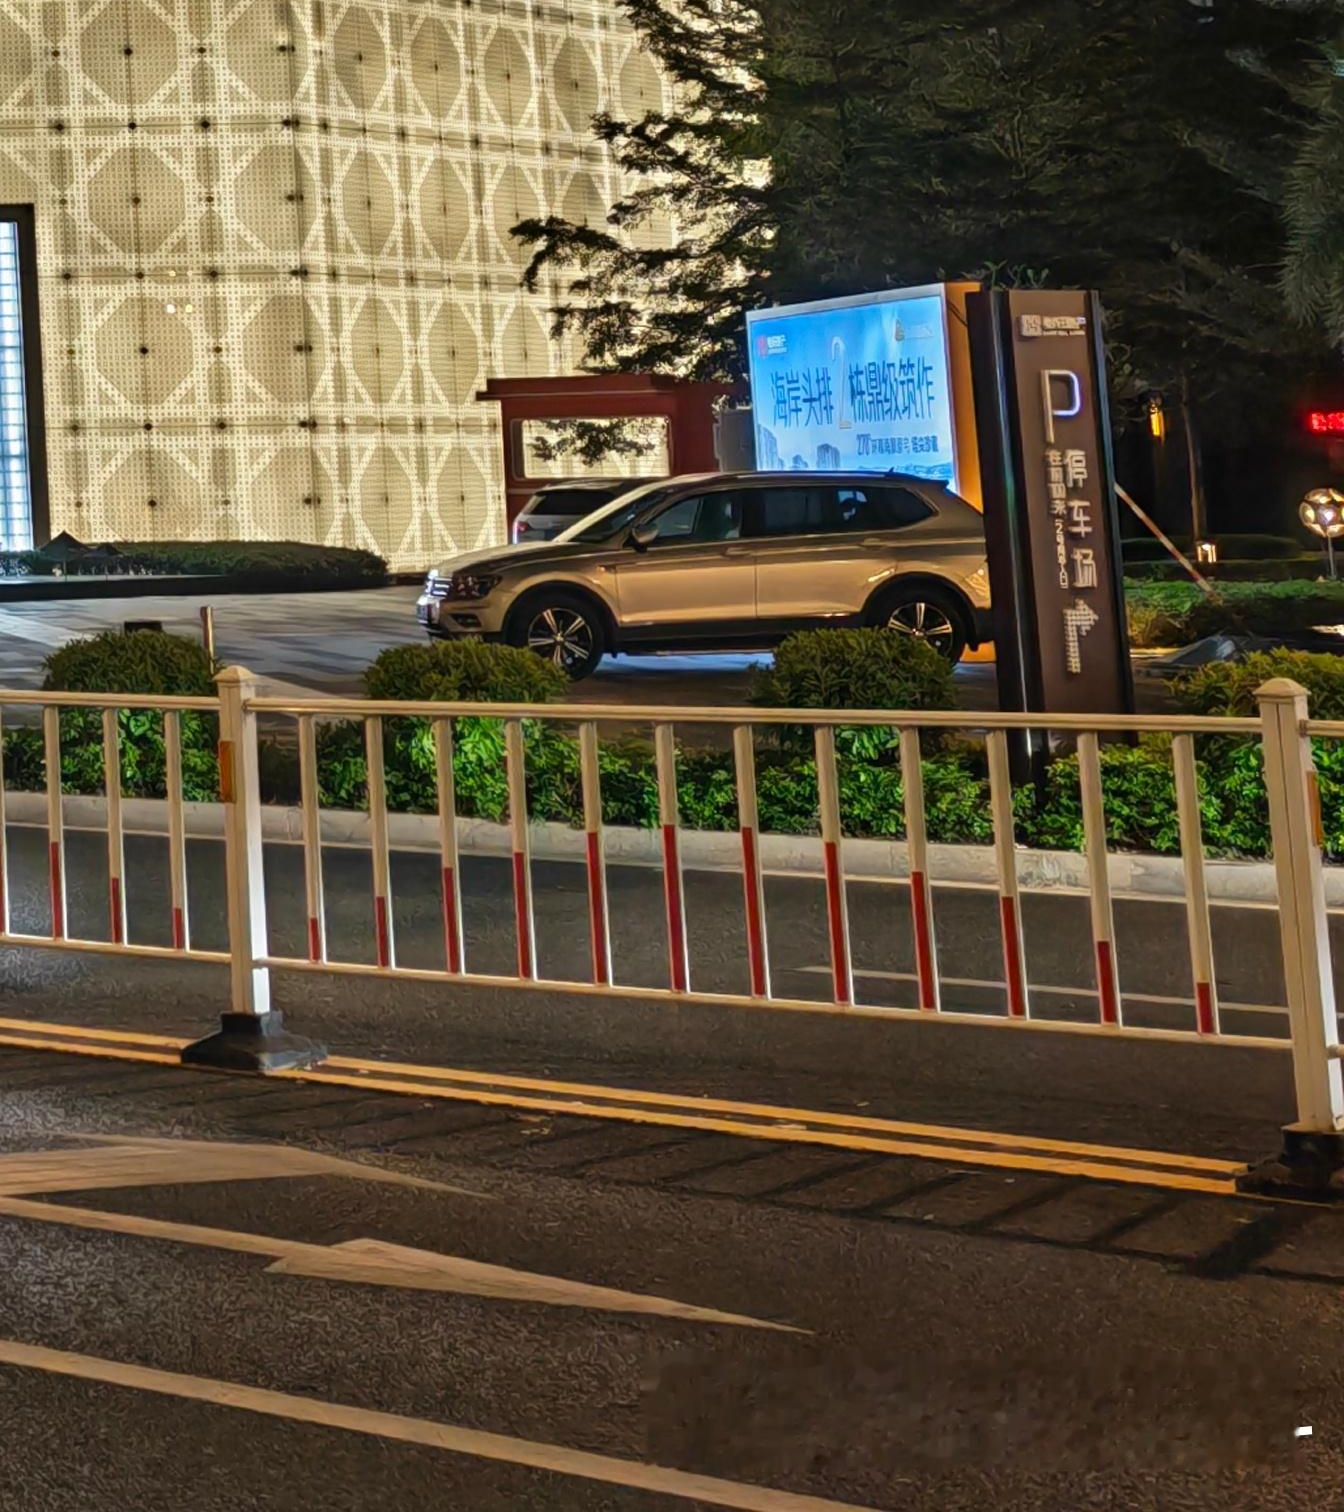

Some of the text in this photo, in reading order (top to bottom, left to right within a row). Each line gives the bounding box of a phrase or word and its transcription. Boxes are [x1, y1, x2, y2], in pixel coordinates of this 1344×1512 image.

[1041, 369, 1081, 445] P
[1063, 448, 1098, 589] 停车场
